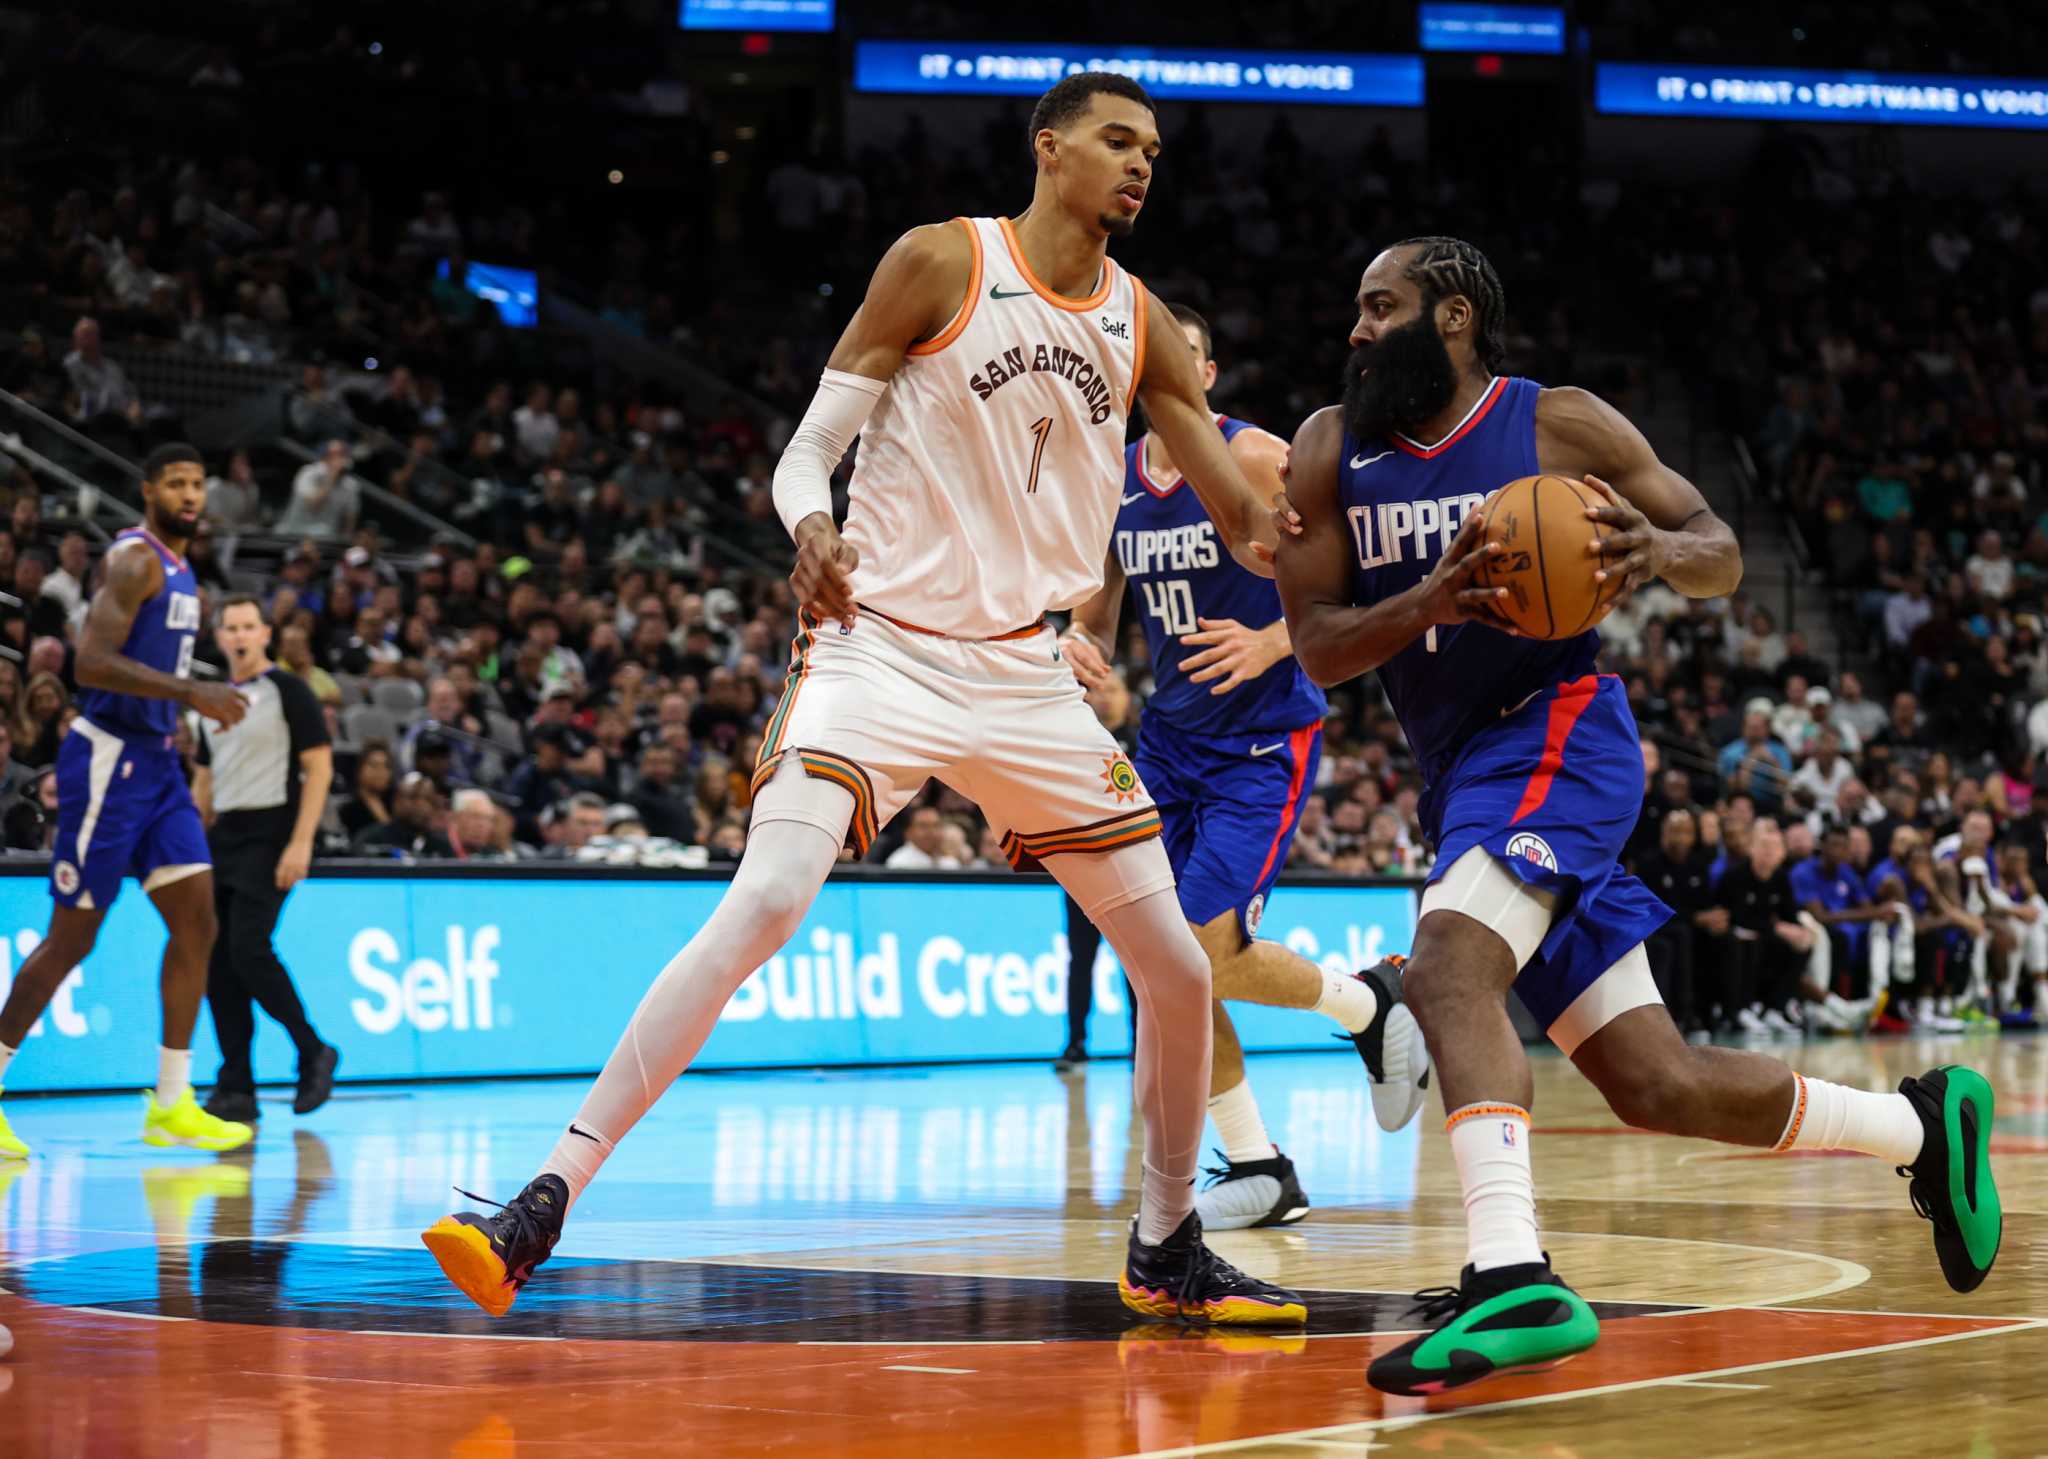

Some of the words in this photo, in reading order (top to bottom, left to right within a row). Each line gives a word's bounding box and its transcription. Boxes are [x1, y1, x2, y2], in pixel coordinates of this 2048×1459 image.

[976, 55, 1065, 81] PRINT
[1263, 63, 1354, 91] VOICE
[1711, 79, 1794, 105] PRINT
[1815, 82, 1959, 112] SOFTWARE
[1981, 88, 2048, 116] VOIC
[969, 346, 1027, 401] SAN
[1031, 344, 1112, 425] ANTONIO
[1027, 416, 1053, 494] 1
[1116, 520, 1220, 577] CLIPPERS
[1347, 489, 1500, 570] CLIPPE
[1142, 579, 1198, 636] 40
[917, 932, 1122, 1019] Credt
